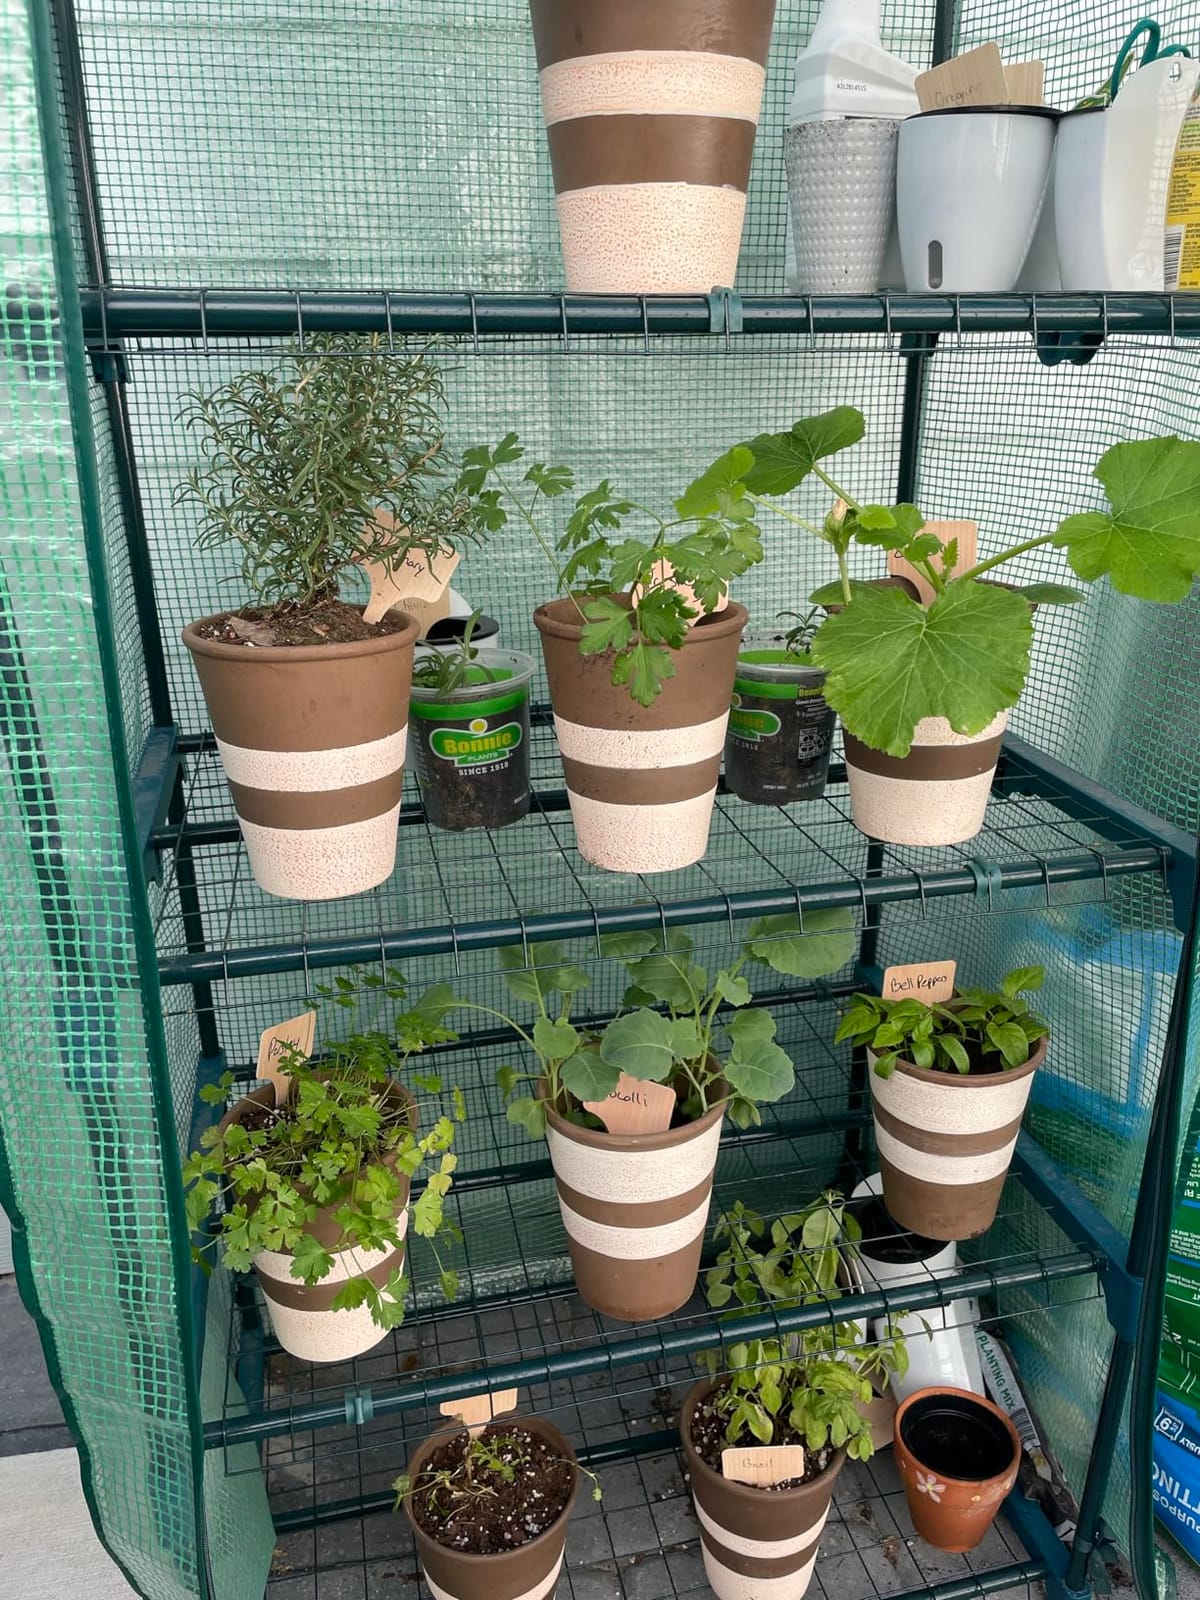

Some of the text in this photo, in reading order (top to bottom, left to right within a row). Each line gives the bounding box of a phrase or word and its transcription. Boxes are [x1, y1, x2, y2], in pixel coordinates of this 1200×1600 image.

[443, 732, 512, 754] Bonnie
[467, 751, 498, 762] PLANTS
[458, 766, 488, 776] SINCE
[890, 977, 914, 992] Bell
[977, 1335, 1006, 1387] PLANTING
[1000, 1388, 1016, 1411] MIX
